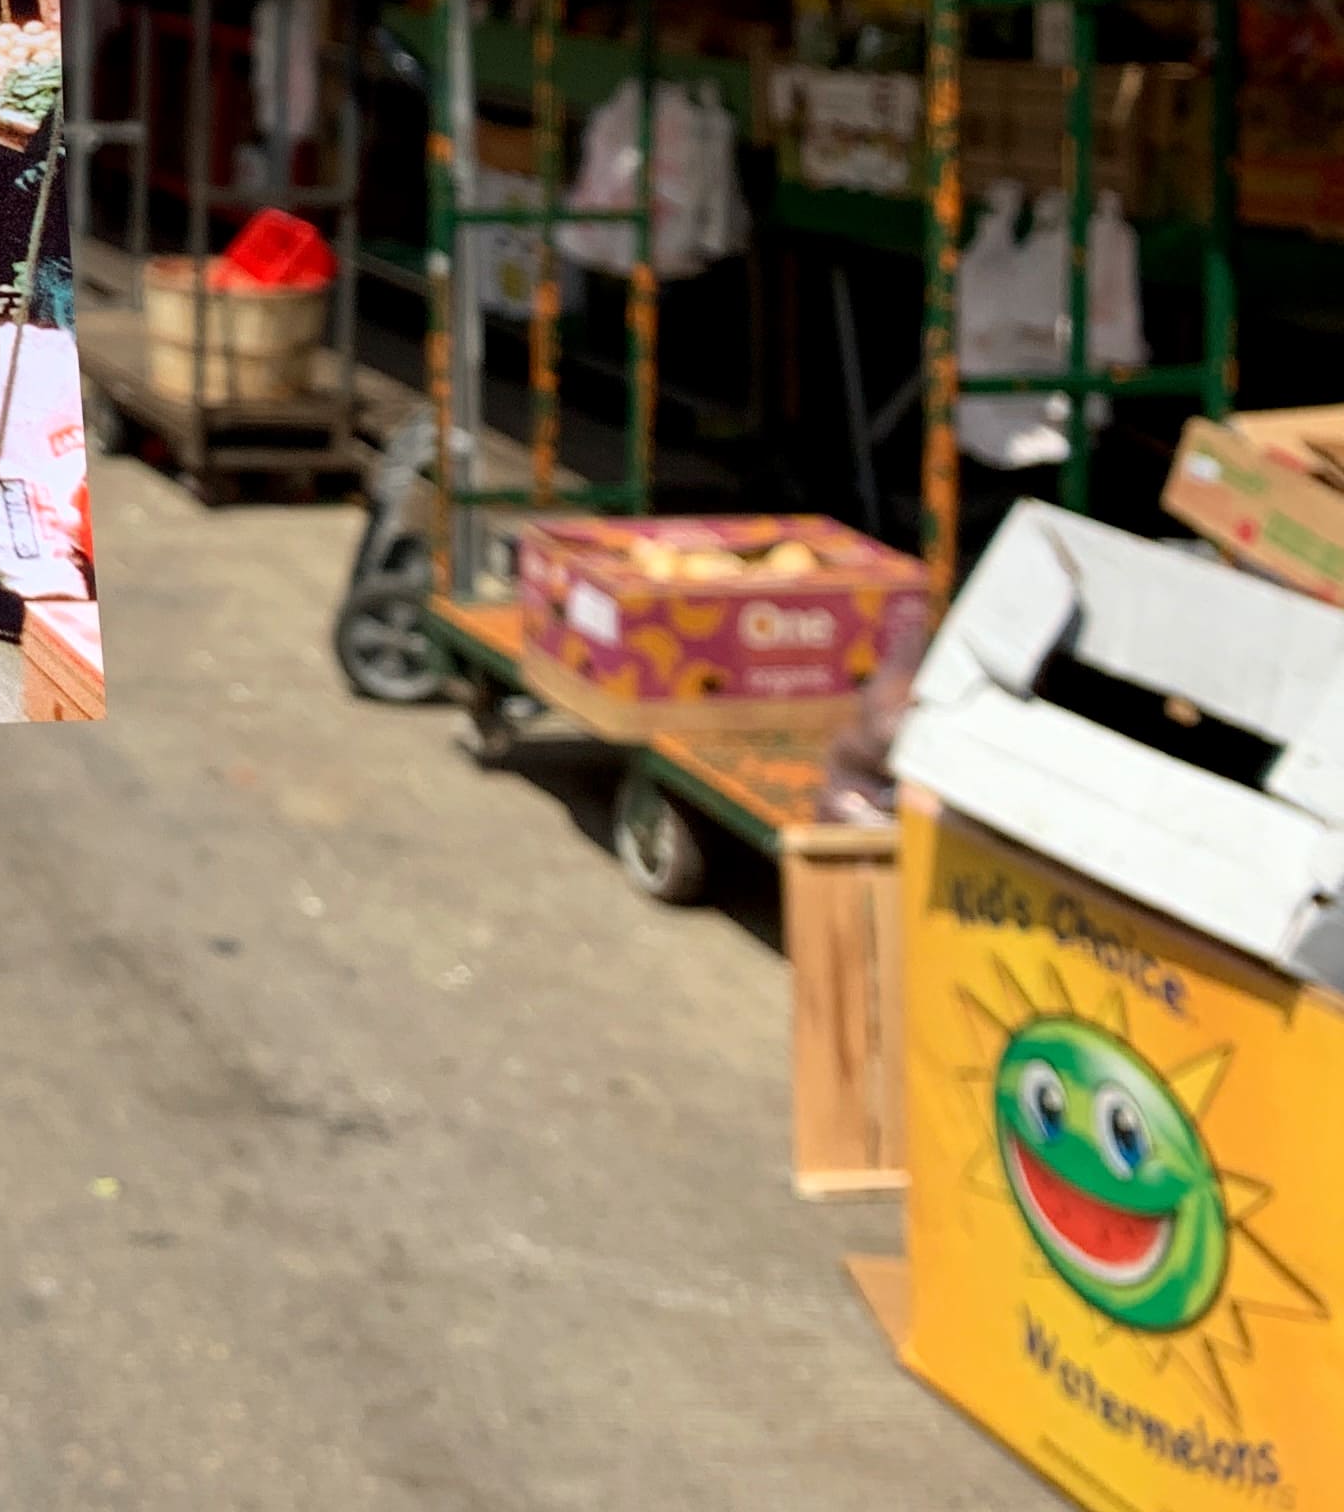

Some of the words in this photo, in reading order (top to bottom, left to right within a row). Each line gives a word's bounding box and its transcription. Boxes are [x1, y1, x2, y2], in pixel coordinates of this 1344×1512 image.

[738, 600, 835, 651] One
[1048, 891, 1188, 1016] Choice
[1016, 1300, 1282, 1488] Watermelons
